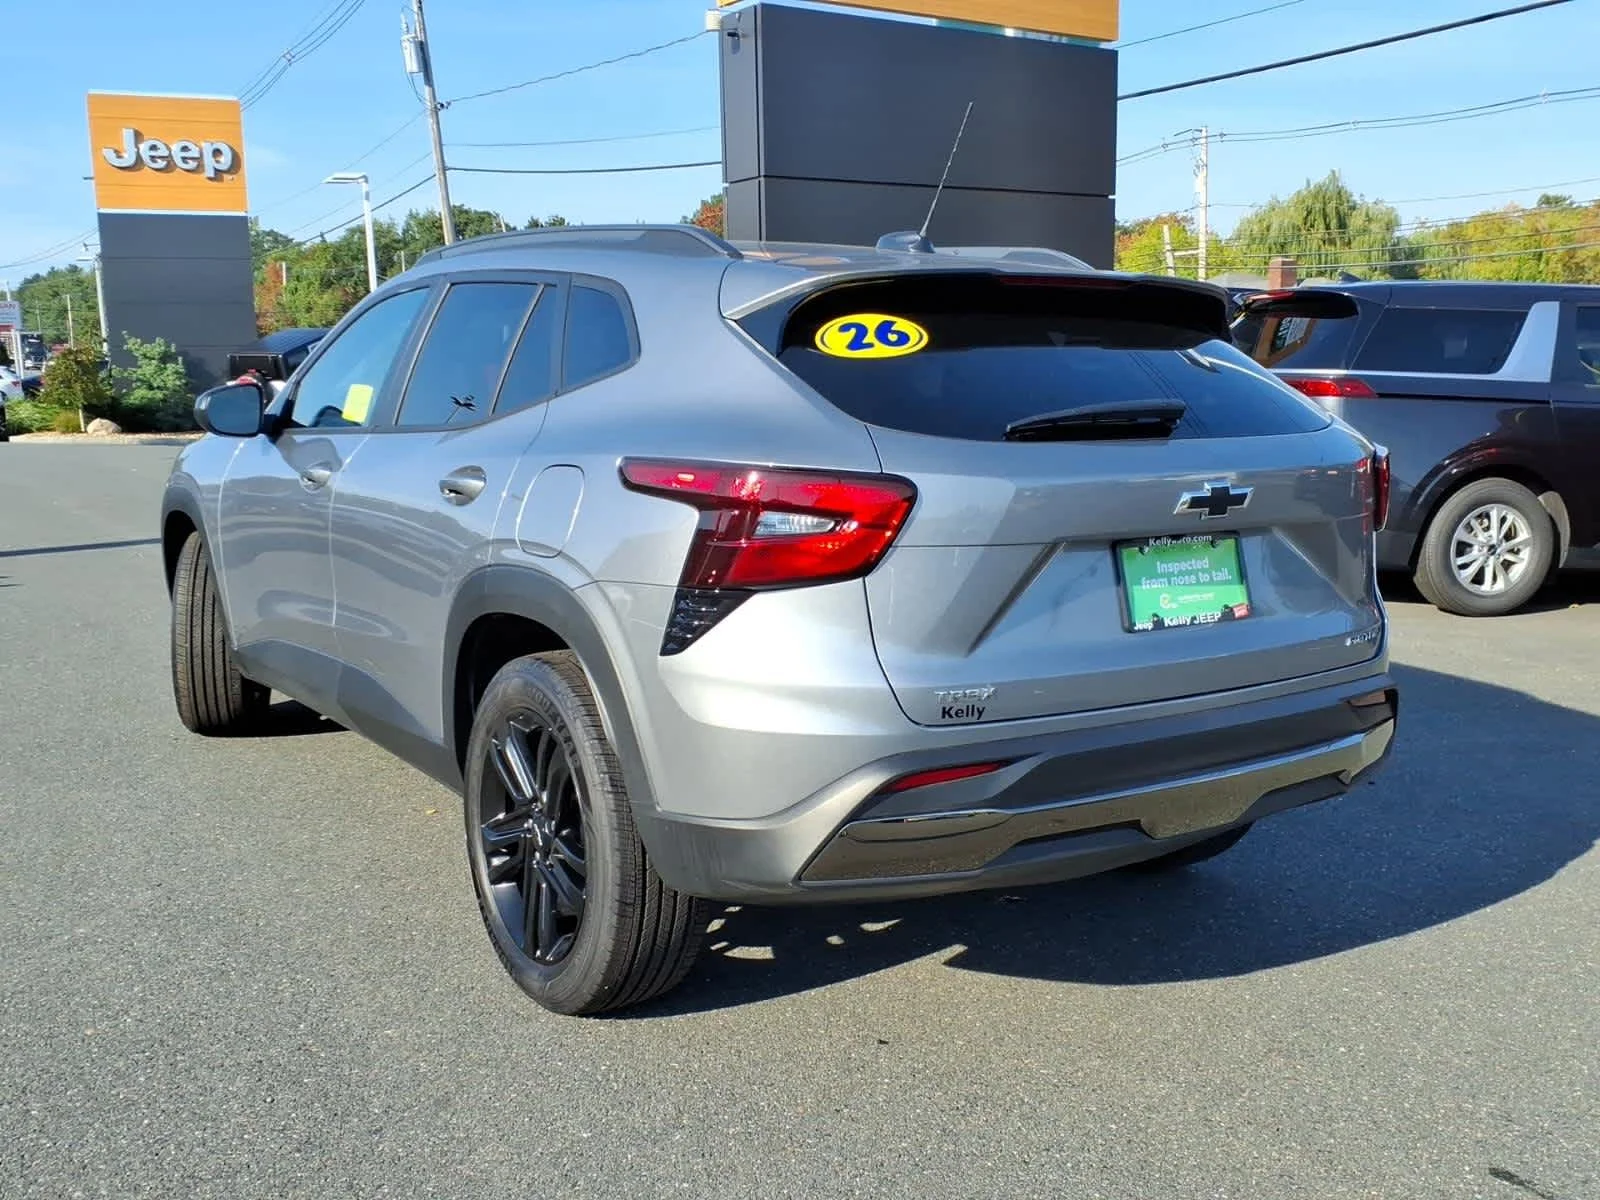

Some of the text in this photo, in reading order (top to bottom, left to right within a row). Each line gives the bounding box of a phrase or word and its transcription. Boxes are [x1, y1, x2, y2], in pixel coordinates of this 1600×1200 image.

[102, 128, 234, 179] Jeep
[838, 320, 911, 351] 26
[1156, 558, 1209, 574] Inspected
[1141, 577, 1168, 590] from
[1171, 575, 1197, 586] nose
[1199, 571, 1211, 582] to
[1133, 621, 1154, 631] Jeep
[1163, 614, 1192, 627] Kelly
[1195, 610, 1222, 624] JEEP
[941, 703, 986, 721] Kelly
